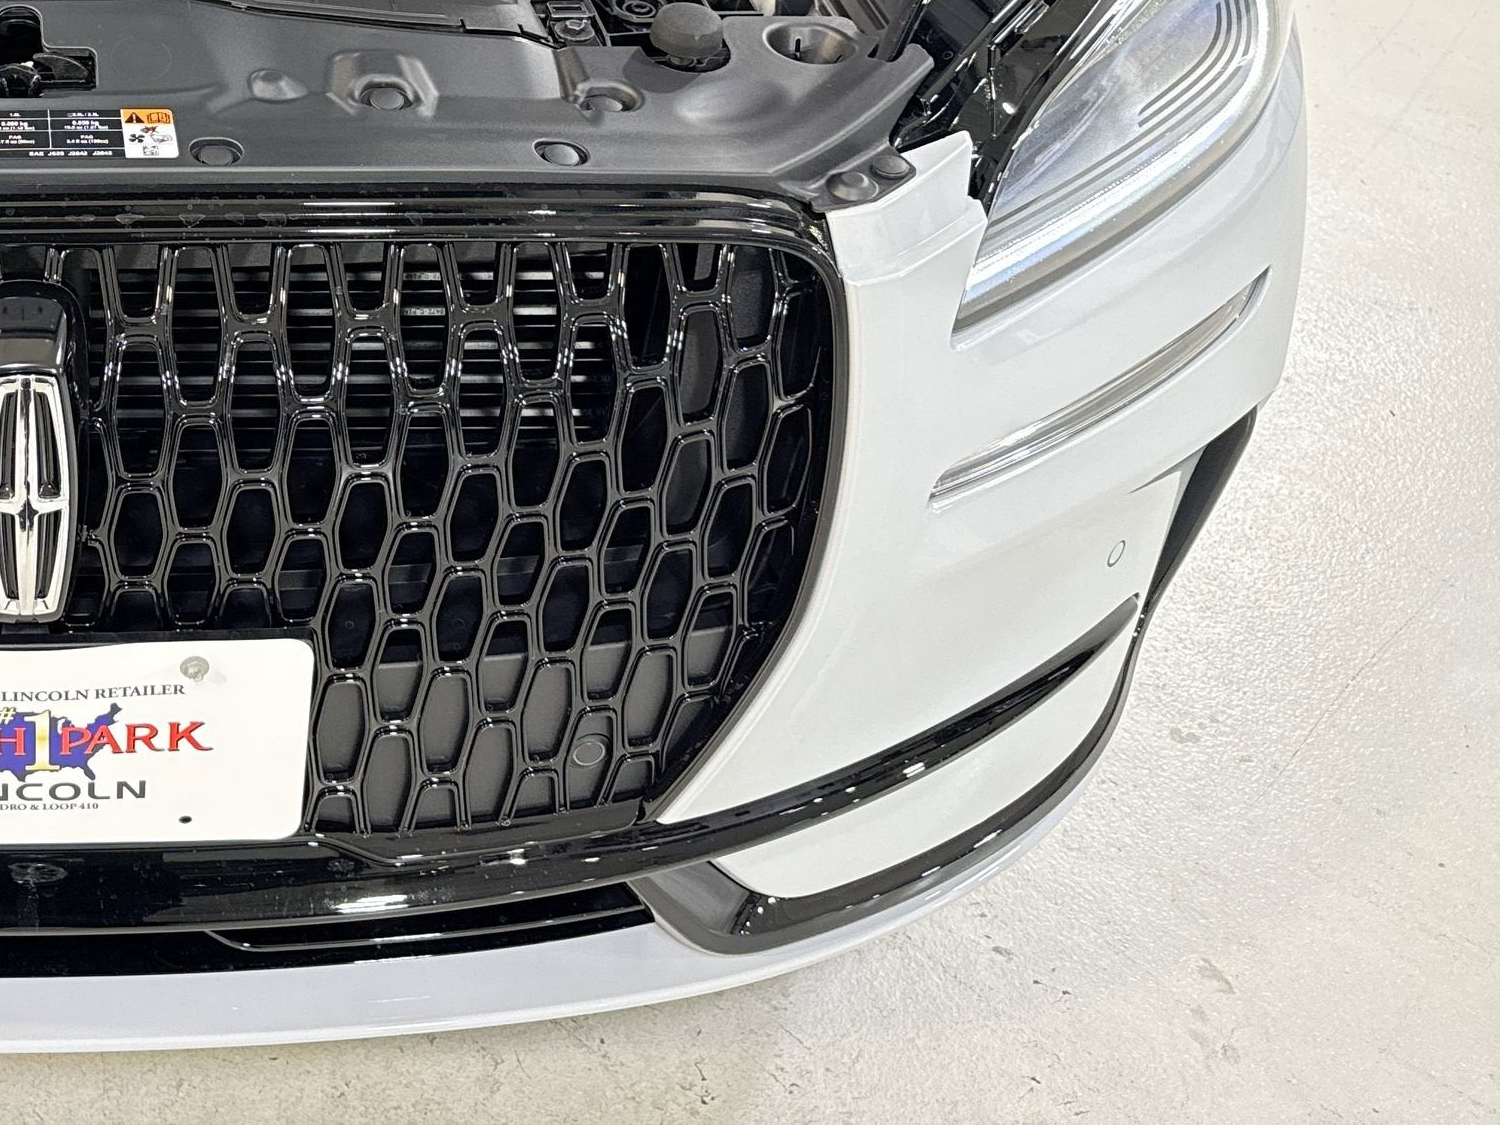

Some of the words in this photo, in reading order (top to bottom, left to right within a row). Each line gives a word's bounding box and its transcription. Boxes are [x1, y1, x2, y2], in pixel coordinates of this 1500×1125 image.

[1, 689, 90, 702] LINCOLN
[95, 684, 186, 699] RETAILER
[60, 721, 214, 754] PARK
[30, 803, 40, 811] &
[42, 802, 78, 811] LOOP
[79, 802, 99, 811] 410
